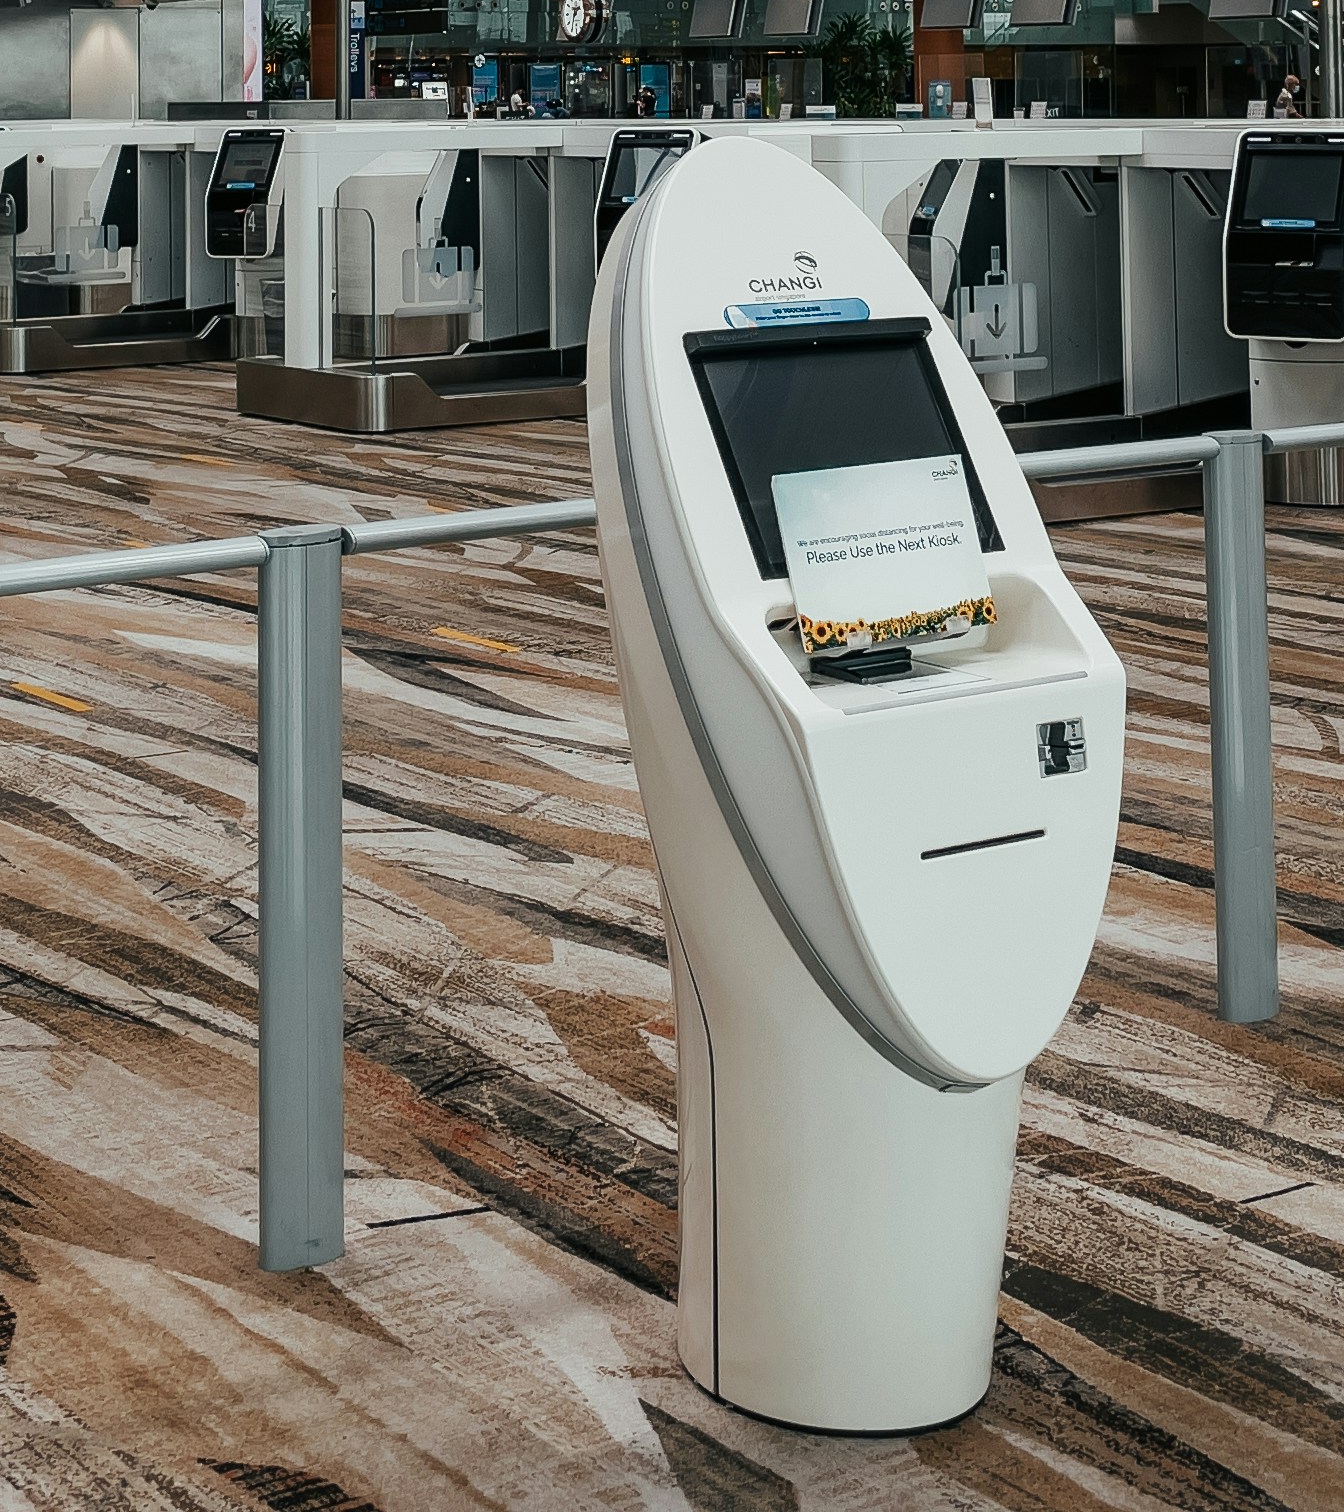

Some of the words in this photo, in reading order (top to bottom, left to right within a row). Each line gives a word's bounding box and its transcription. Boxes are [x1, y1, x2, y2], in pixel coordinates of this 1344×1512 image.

[350, 33, 360, 73] Trolleys
[1047, 108, 1059, 118] XIT
[248, 211, 256, 232] 4
[748, 276, 823, 293] CHANGI
[877, 526, 908, 536] distancing
[908, 525, 918, 534] for
[806, 549, 847, 565] Please
[849, 544, 874, 559] Use
[875, 541, 896, 555] the
[898, 536, 927, 552] Next
[928, 532, 962, 548] Kiosk.
